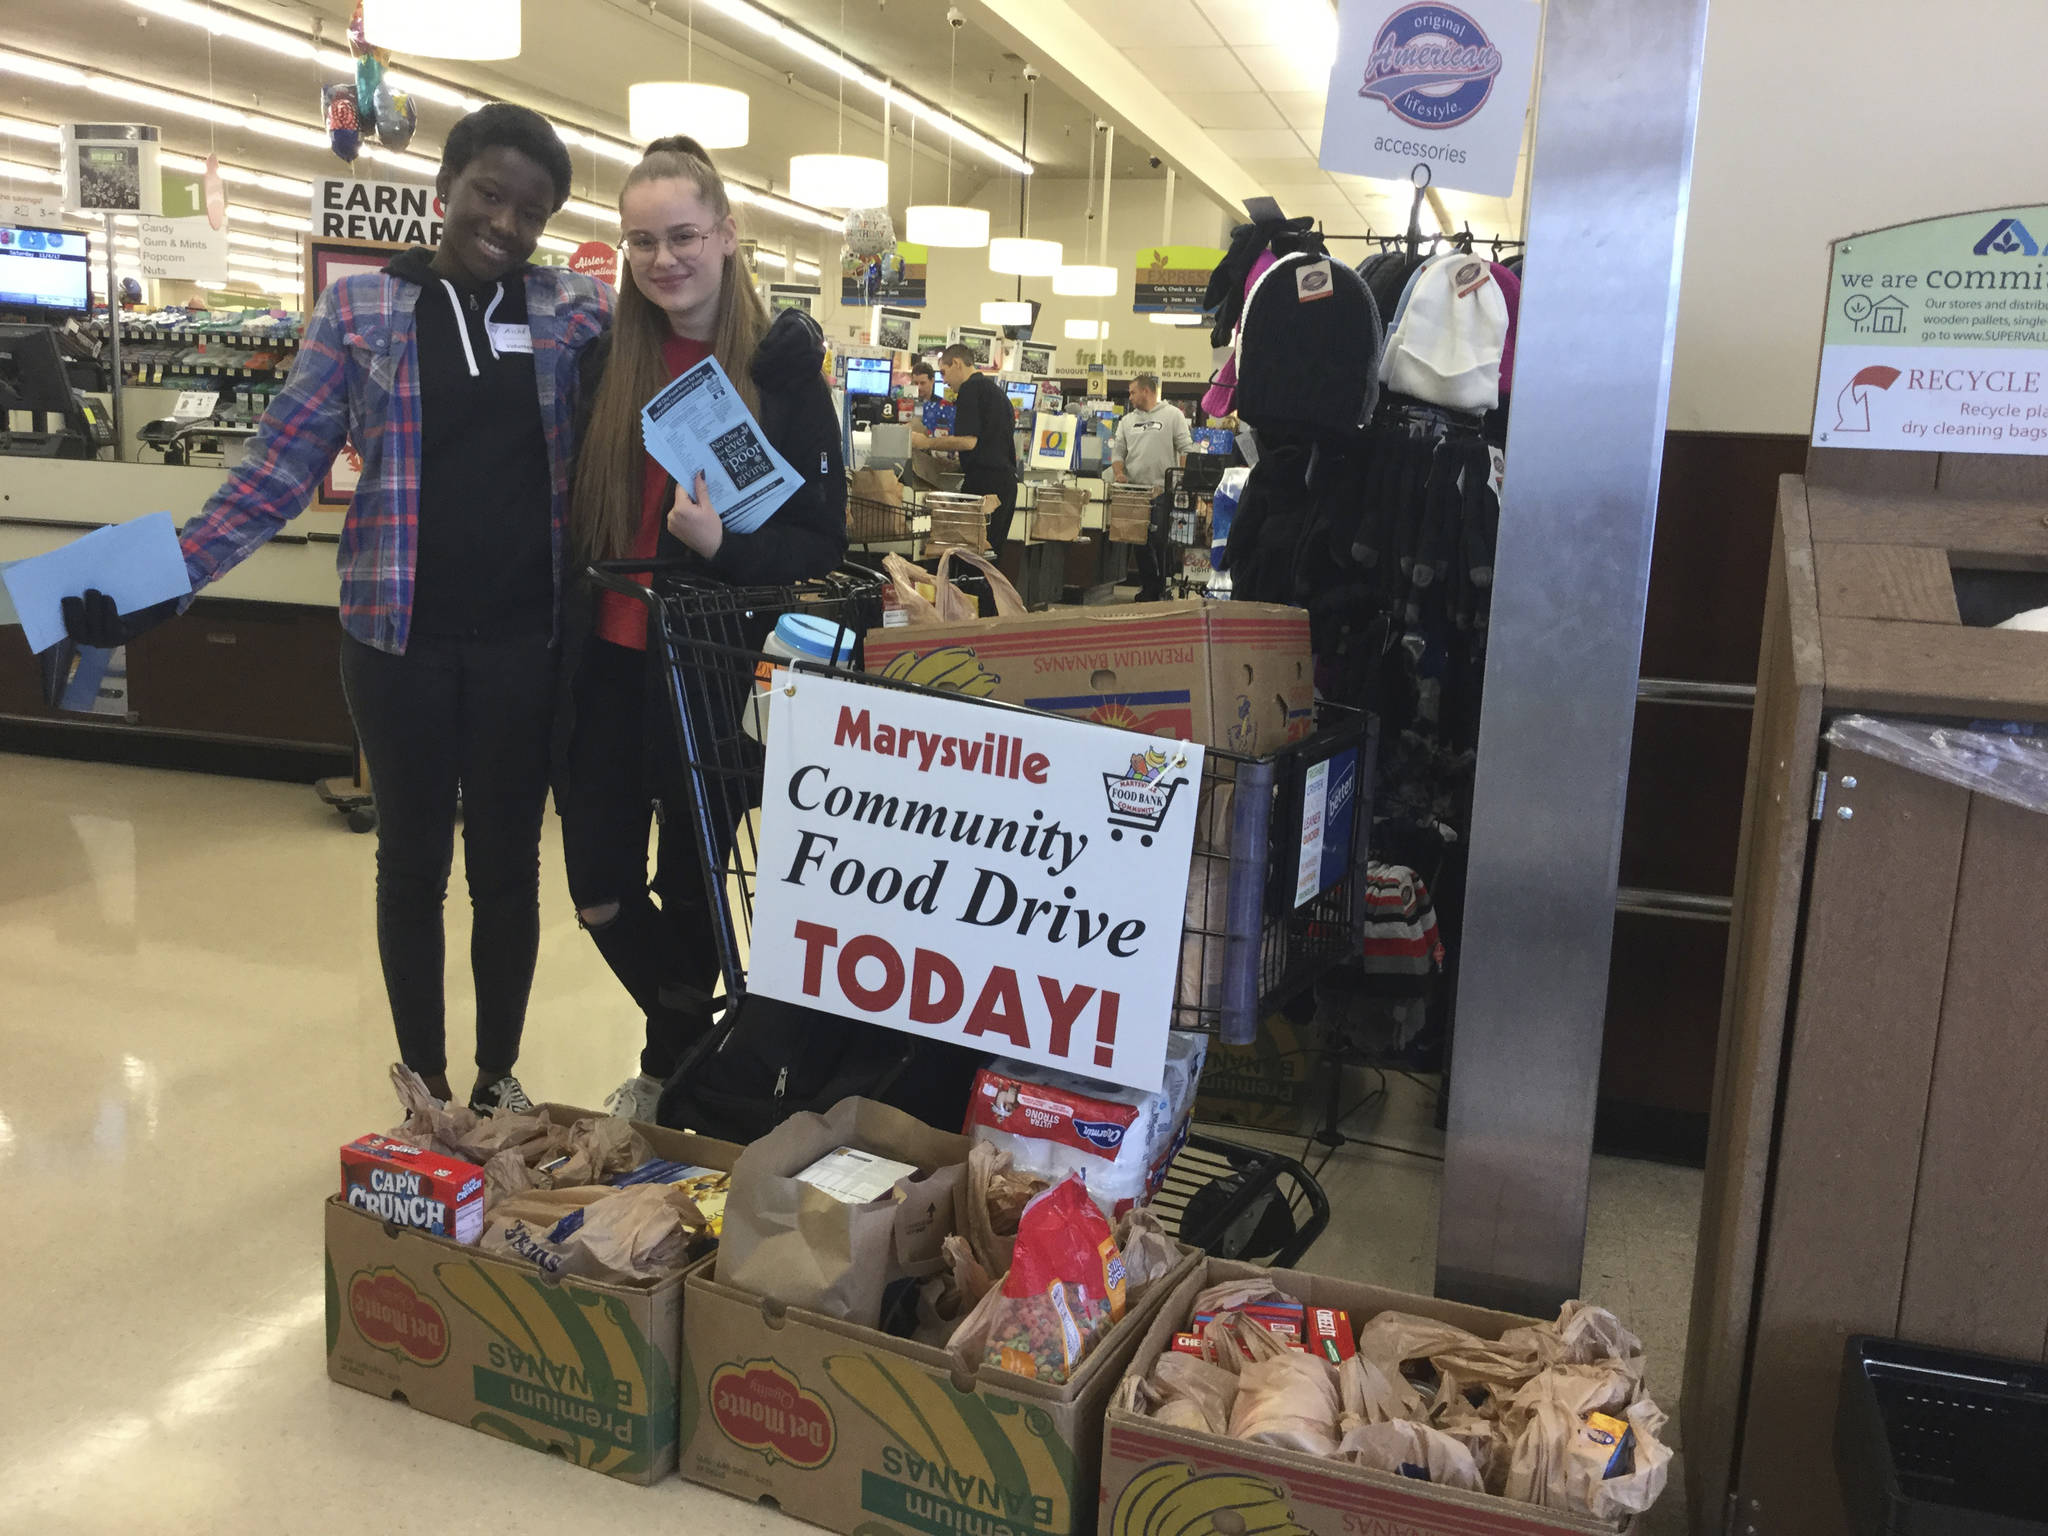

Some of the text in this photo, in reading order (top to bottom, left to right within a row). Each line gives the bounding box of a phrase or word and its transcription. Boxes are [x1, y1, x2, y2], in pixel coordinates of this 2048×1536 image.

[1414, 12, 1466, 37] original
[1366, 31, 1499, 79] American
[1404, 94, 1458, 120] lifestyle
[1374, 136, 1467, 164] accessories
[184, 183, 200, 211] 1
[323, 181, 428, 217] EARN
[142, 222, 175, 235] Candy
[143, 238, 208, 250] Gum & Mints
[142, 251, 186, 264] Popcorn
[142, 265, 167, 276] Nuts
[1841, 263, 2048, 290] we are commi
[1925, 298, 1946, 309] Our
[1949, 300, 1982, 310] stores
[1985, 300, 2006, 310] and
[1923, 314, 1969, 325] wooden
[1972, 315, 2011, 328] pallets,
[1921, 332, 1936, 342] go
[1939, 331, 1950, 340] to
[1091, 380, 1099, 390] 9
[1908, 368, 2041, 393] RECYCLE
[882, 403, 893, 415] a
[1960, 402, 2021, 418] Recycle
[711, 429, 739, 451] No One
[1902, 420, 1928, 437] dry
[1933, 422, 2003, 439] cleaning
[723, 434, 749, 454] ever
[728, 442, 765, 473] poor
[1033, 646, 1194, 674] PREMIUM BANANAS
[834, 705, 1051, 785] Marysville
[1112, 788, 1163, 807] FOOD BANK
[1117, 801, 1155, 816] COMMUNITY
[1328, 775, 1354, 817] better
[787, 765, 1088, 877] Community
[781, 829, 1147, 958] Food Drive
[794, 919, 1121, 1069] TODAY!
[1025, 1108, 1060, 1125] STRONG
[1030, 1118, 1052, 1129] ULTRA
[1083, 1125, 1122, 1143] Charmin
[371, 1168, 421, 1196] CAP'N
[349, 1186, 447, 1230] CRUNCH
[355, 1293, 410, 1335] Monte
[410, 1316, 441, 1346] Del
[509, 1382, 633, 1443] Premium
[718, 1390, 825, 1448] Del Monte
